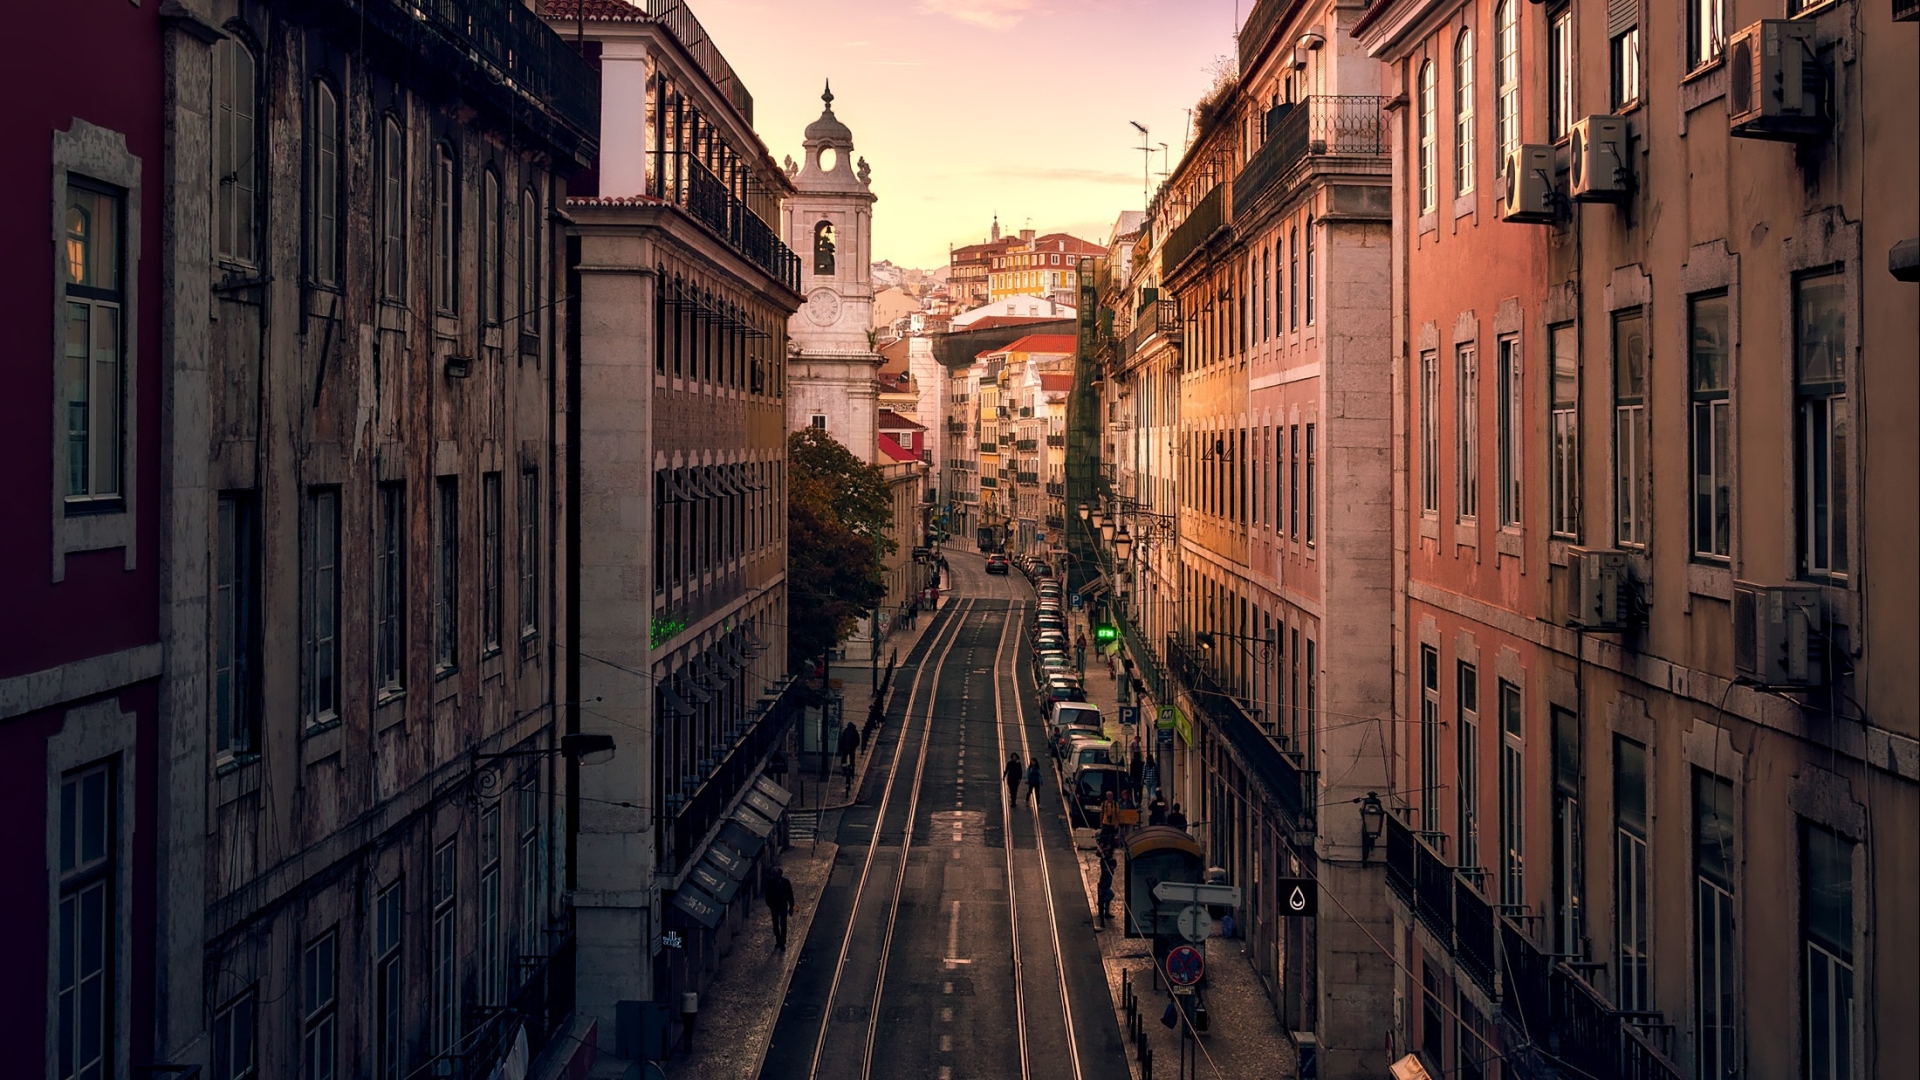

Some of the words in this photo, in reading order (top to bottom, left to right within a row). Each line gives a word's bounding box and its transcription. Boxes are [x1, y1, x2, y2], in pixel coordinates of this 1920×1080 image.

[1072, 595, 1079, 604] P
[1122, 708, 1133, 722] P
[1162, 709, 1172, 719] M
